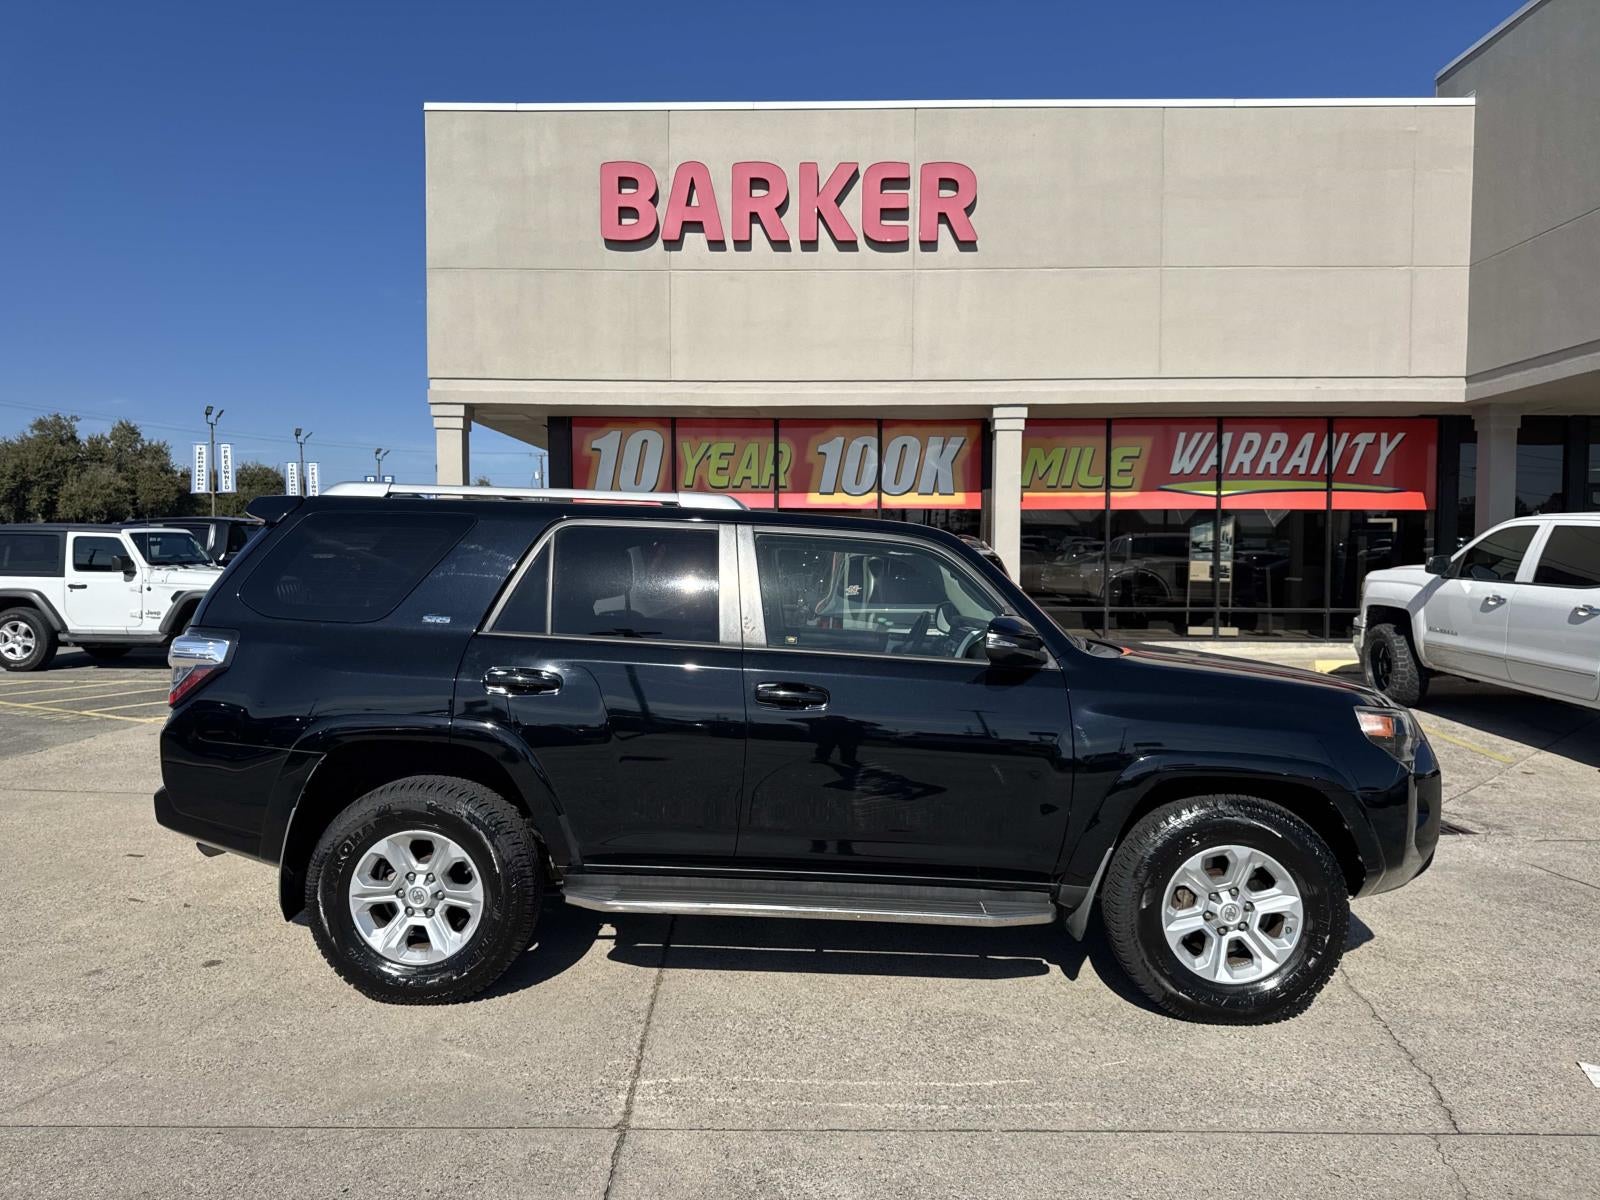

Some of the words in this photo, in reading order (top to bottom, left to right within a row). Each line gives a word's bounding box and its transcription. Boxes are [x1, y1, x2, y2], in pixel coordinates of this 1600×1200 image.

[600, 161, 978, 251] BARKER
[591, 429, 665, 493] 10
[680, 440, 792, 490] YEAR
[816, 435, 967, 496] 100K
[1021, 446, 1142, 489] MILE
[1168, 431, 1408, 476] WARRANTY
